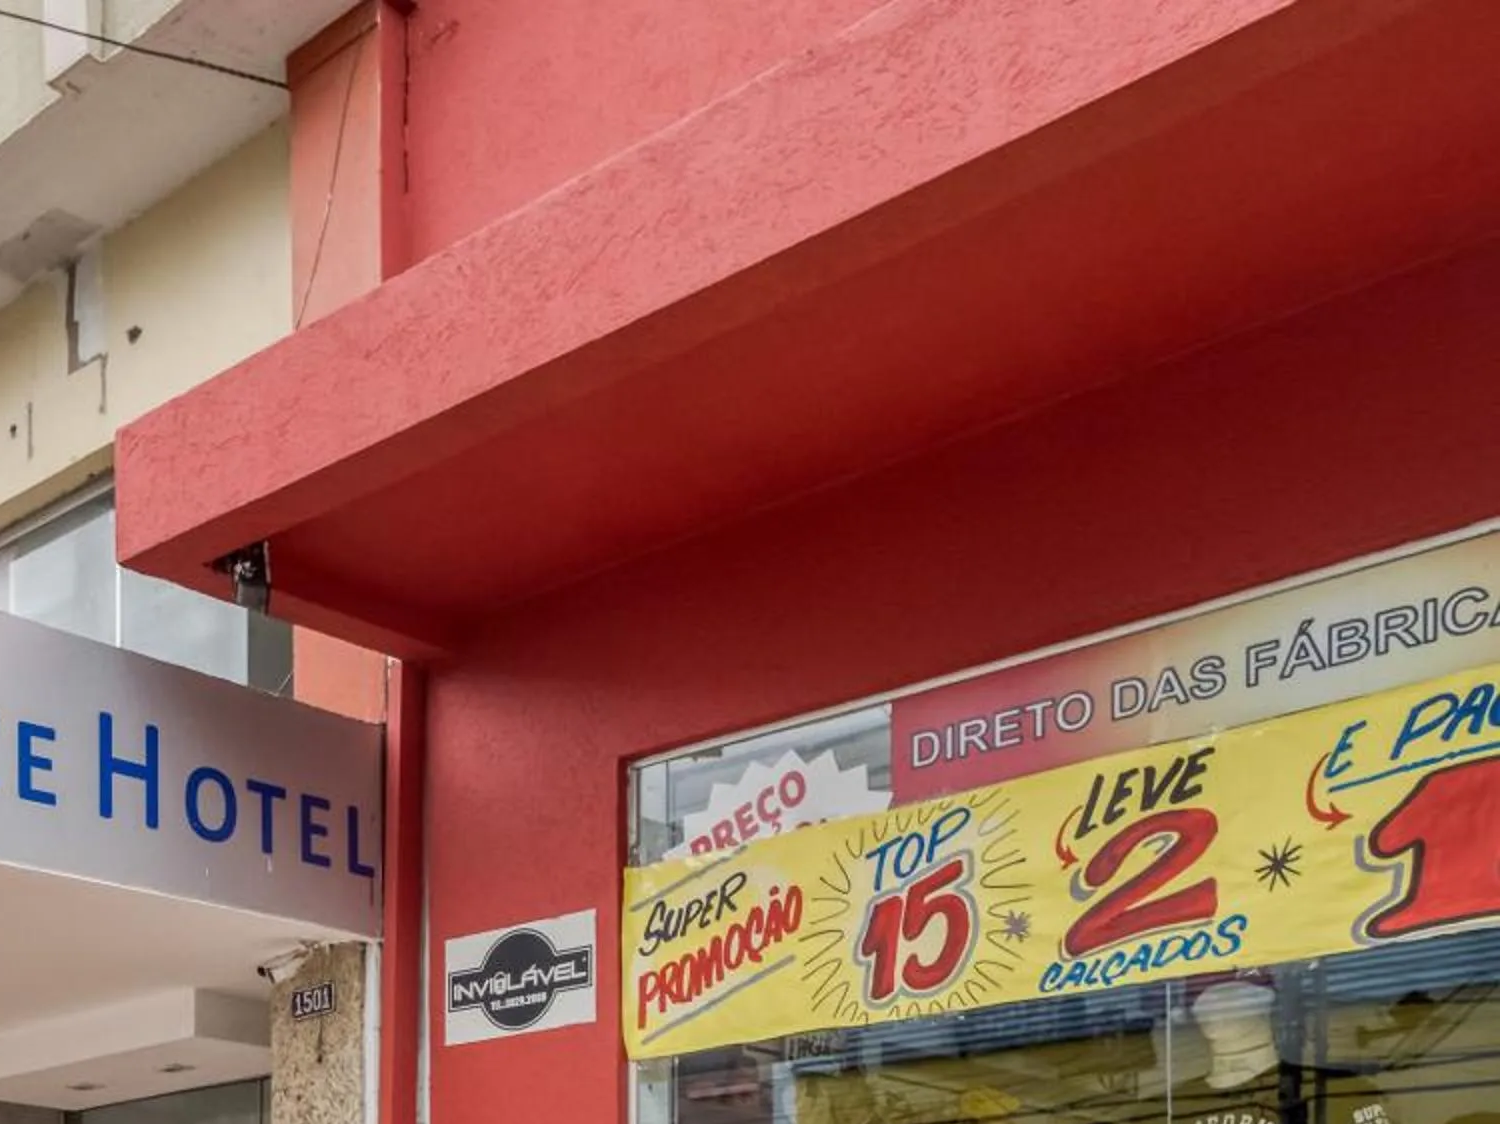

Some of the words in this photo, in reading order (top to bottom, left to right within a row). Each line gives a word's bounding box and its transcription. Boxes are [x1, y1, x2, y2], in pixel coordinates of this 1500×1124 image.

[910, 691, 1095, 769] DIRETO
[1111, 655, 1227, 722] DAS
[1245, 585, 1500, 688] FÁBRIC
[1323, 720, 1367, 779] E
[1390, 682, 1500, 761] PA
[99, 711, 377, 879] HOTEL
[689, 770, 806, 857] PREÇO
[1073, 746, 1216, 840] LEVE
[865, 807, 971, 892] TOP
[1064, 807, 1219, 958] 2
[638, 871, 748, 957] SUPER
[861, 859, 971, 1001] 15
[1039, 913, 1248, 993] CALÇADOS
[294, 986, 331, 1017] 1501
[453, 961, 587, 1002] INVIOLÁVEL
